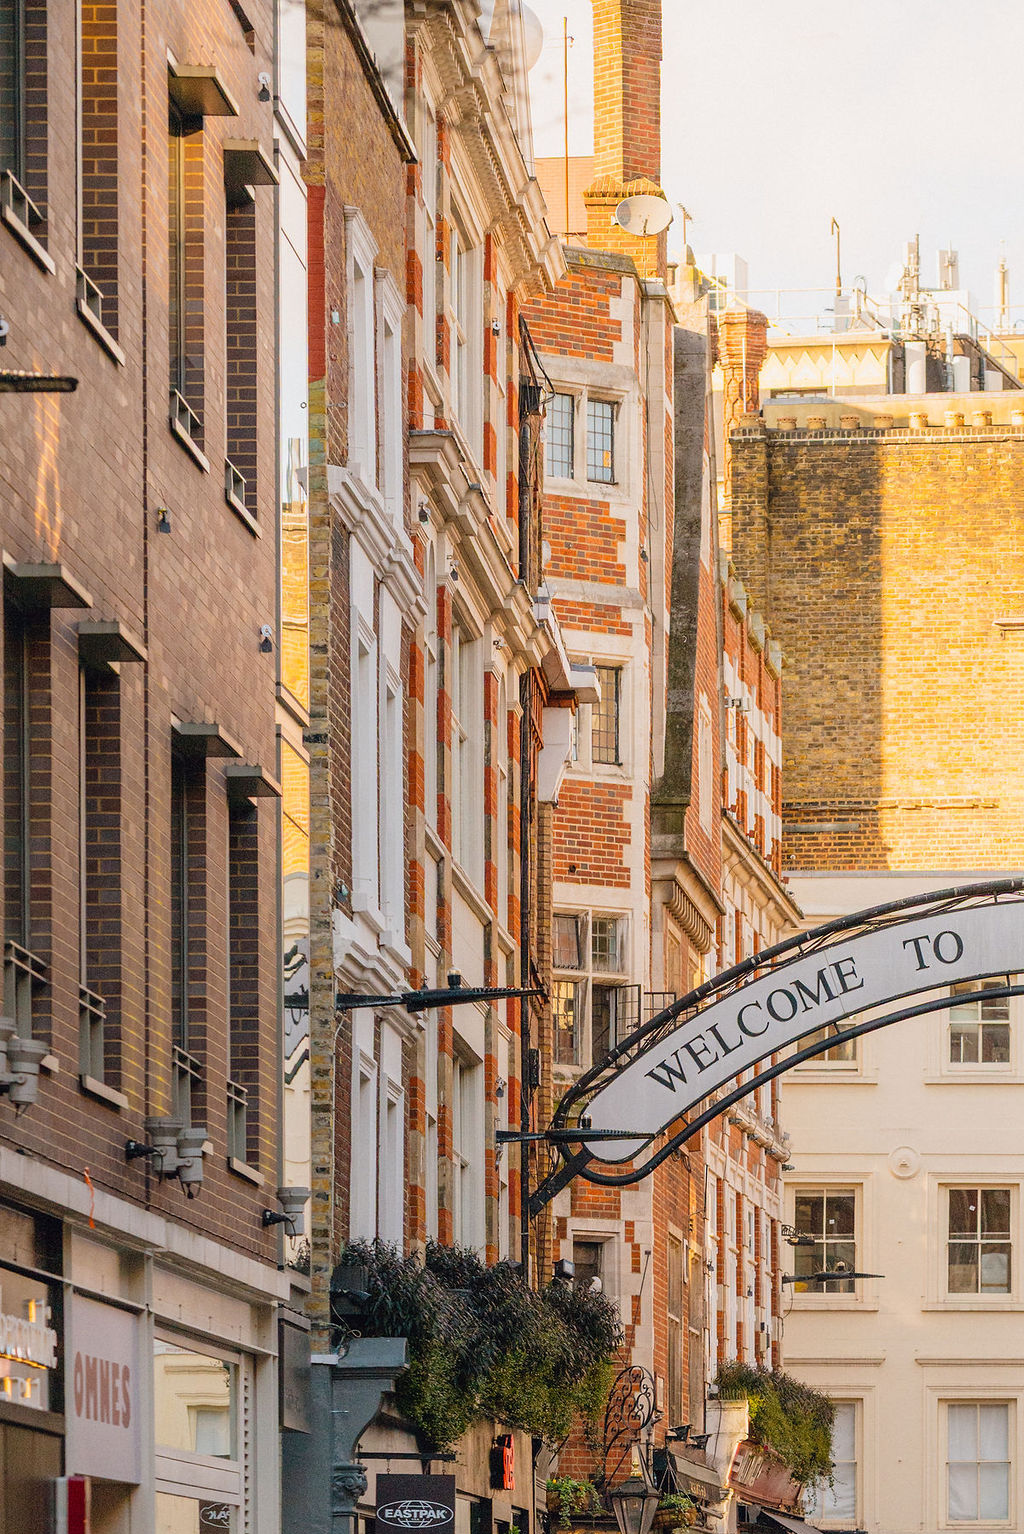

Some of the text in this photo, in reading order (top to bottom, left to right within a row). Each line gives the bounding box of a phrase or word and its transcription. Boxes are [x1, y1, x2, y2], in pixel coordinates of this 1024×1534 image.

[644, 957, 864, 1092] WELCOME
[903, 930, 964, 971] TO
[74, 1351, 131, 1429] OMNES
[385, 1509, 446, 1519] EASTPAK
